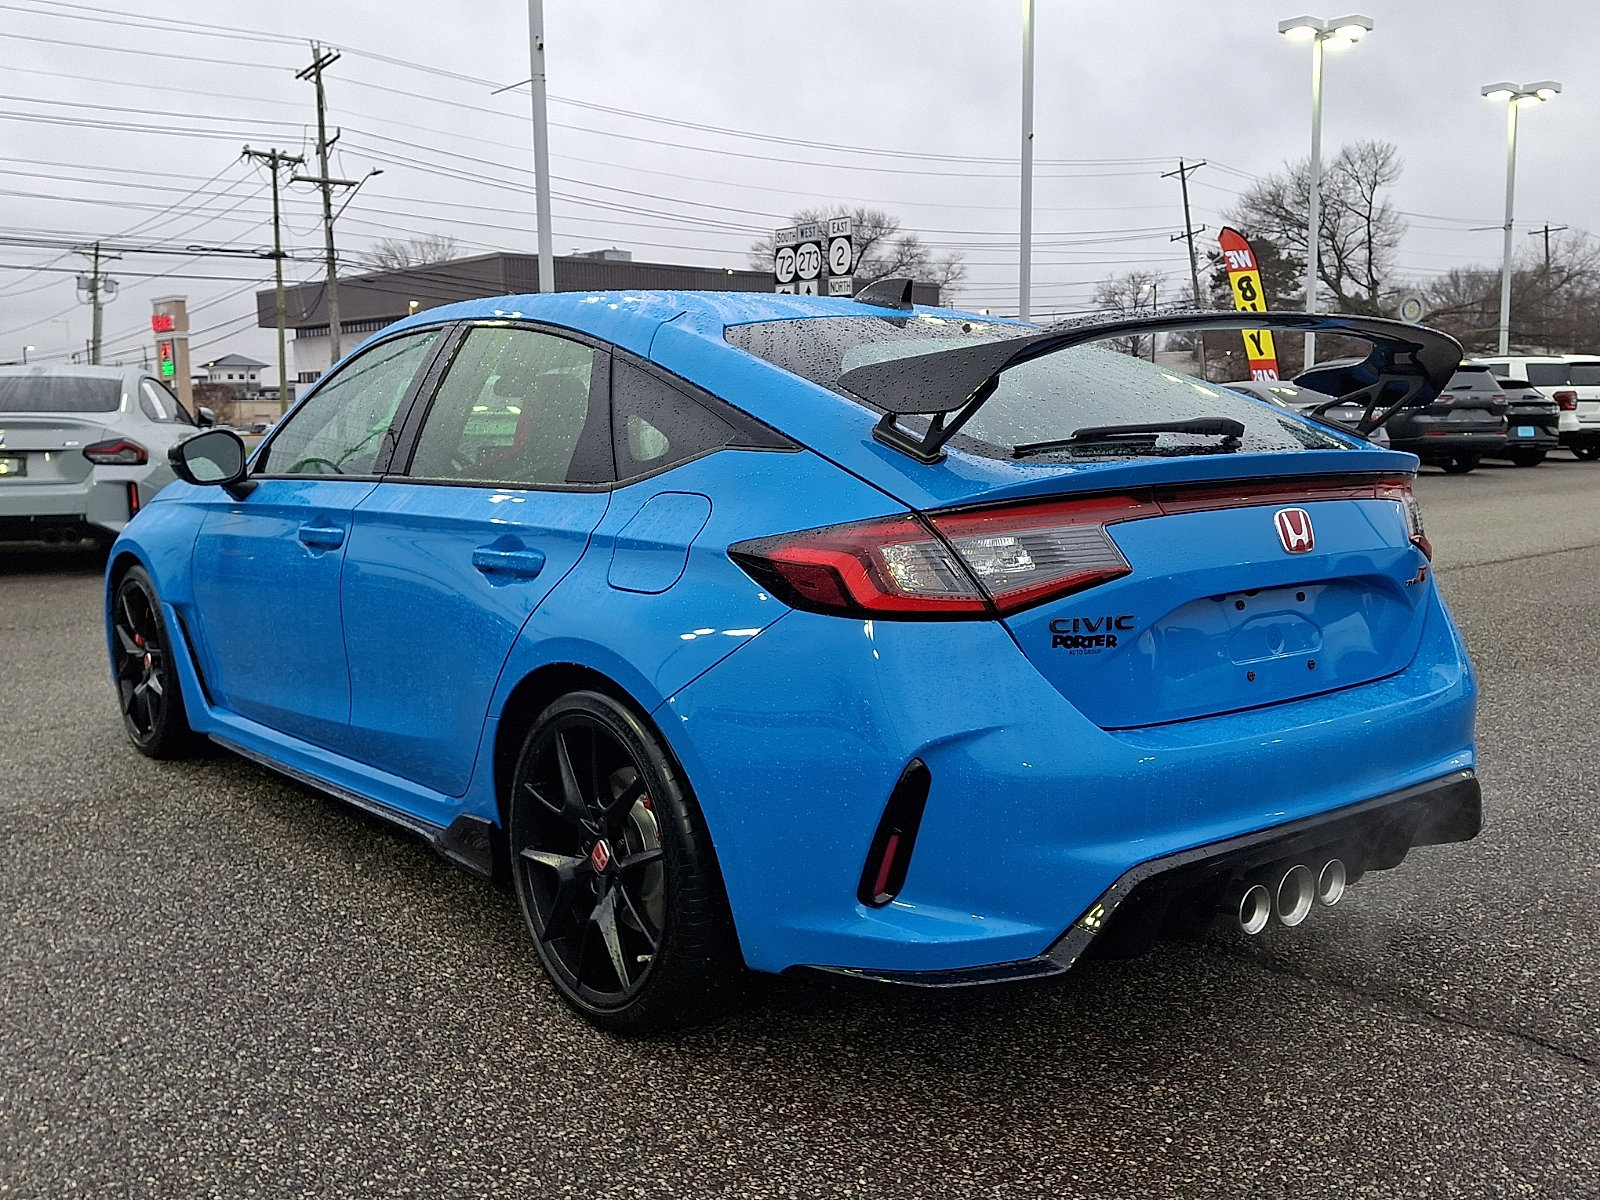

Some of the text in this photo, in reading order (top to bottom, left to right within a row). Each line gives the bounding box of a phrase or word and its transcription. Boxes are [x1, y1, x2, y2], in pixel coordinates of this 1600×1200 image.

[800, 226, 816, 239] WEST
[832, 221, 848, 234] EAST
[777, 231, 796, 243] SOUTH
[798, 250, 819, 272] 273
[836, 246, 845, 266] 2
[778, 255, 794, 275] 72
[830, 280, 851, 293] NORTH
[1049, 614, 1135, 634] CIVIC
[1051, 634, 1118, 649] PORTER
